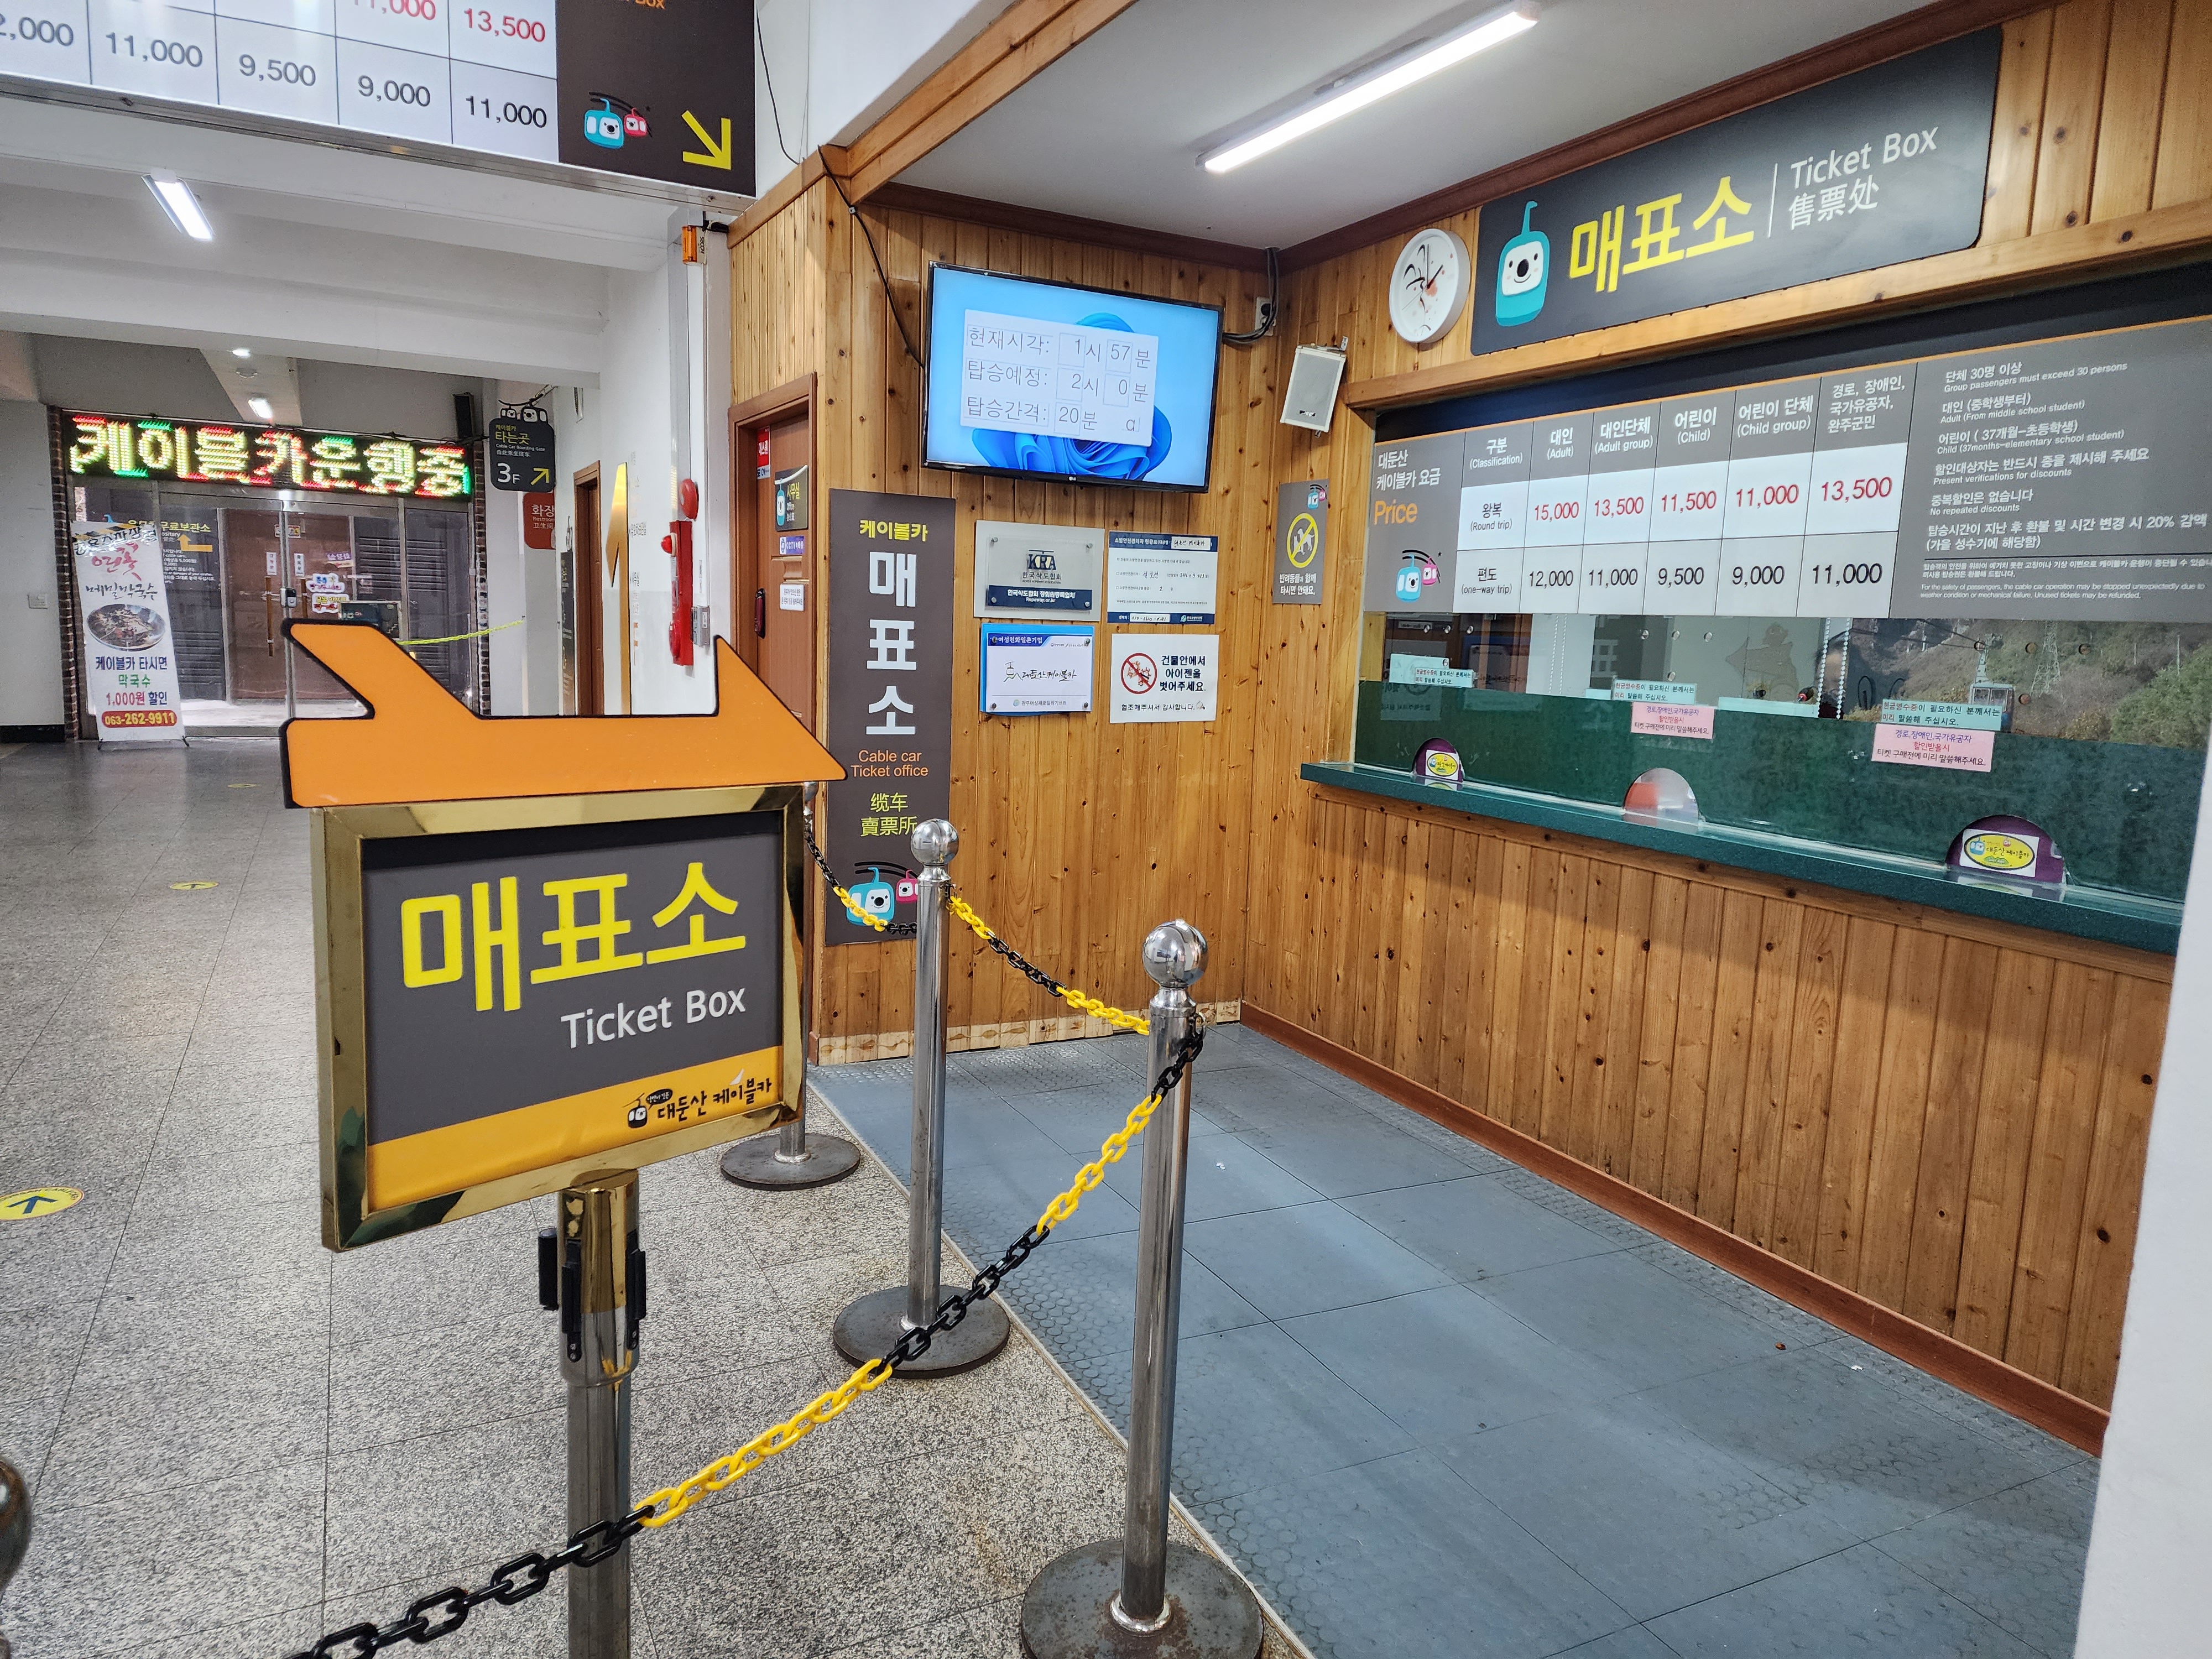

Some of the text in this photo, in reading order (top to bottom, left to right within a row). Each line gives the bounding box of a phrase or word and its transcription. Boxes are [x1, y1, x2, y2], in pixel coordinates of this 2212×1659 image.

[464, 8, 545, 42] 13,500
[106, 32, 202, 67] 11,000
[239, 54, 316, 86] 9,500
[358, 75, 431, 106] 9,000
[466, 96, 547, 127] 11,000
[1791, 126, 1939, 190] Ticket Box
[1789, 174, 1880, 231] 售票处
[1568, 175, 1755, 294] 매표소
[967, 361, 1047, 387] 탑승예정:
[1944, 363, 2128, 393] Group passengers must exceed 30 persons
[1945, 362, 2022, 383] 단체 30명 이상
[1832, 375, 1905, 399] 경로, 장애인,
[967, 396, 1046, 422] 탑승간격:
[1739, 395, 1813, 421] 어린이 단체
[1830, 395, 1893, 416] 국가유공자,
[1940, 399, 2085, 424] Adult (From middle school student)
[1943, 392, 2031, 414] 대인 (중학생부터)
[1601, 416, 1651, 438] 대인단체
[1675, 406, 1717, 430] 어린이
[1737, 416, 1812, 438] (Child group)
[1828, 415, 1876, 434] 완주군민
[495, 431, 530, 445] 타는곳
[1551, 427, 1573, 445] 대인
[1595, 436, 1653, 455] (Adult group)
[1678, 428, 1710, 445] (Child)
[1937, 429, 2125, 455] Child school student)
[1939, 431, 1970, 445] 어린이
[1486, 437, 1507, 455] 구분
[1547, 446, 1574, 460] (Adult)
[1378, 450, 1408, 469] 대둔산
[1470, 452, 1523, 469] (Classification)
[1936, 448, 2150, 476] 할인대상자는 반드시 증을 제시해 주세요
[497, 463, 520, 484] 3F
[1376, 468, 1441, 491] 케이블카 요금
[1933, 467, 2073, 486] Present verifications for discounts
[787, 482, 800, 500] 사무실
[1535, 476, 1892, 523] 15,000 13,500 11,500 11,000 13,500
[1932, 488, 2033, 507] 중복할인은 없습니다
[1374, 500, 1418, 525] Price
[1482, 502, 1502, 519] 왕복
[1943, 505, 1978, 515] repeated
[1981, 504, 2020, 513] discounts
[859, 520, 928, 541] 케이블카
[1470, 519, 1512, 531] (Round trip)
[1928, 514, 2208, 537] 탑승시간이 지난 후 환불 및 시간 변경 시 20% 감액
[1927, 537, 1998, 551] (가을 성수기에
[1280, 573, 1316, 583] 반려동물과 함께
[1478, 567, 1497, 582] 편도
[1529, 563, 1882, 588] 12,000 11,000 9,500 9,000 11,000
[1280, 586, 1296, 596] 타시면
[1462, 583, 1512, 595] (one-way trip)
[866, 551, 917, 734] 매표소
[96, 656, 167, 670] 케이블카 타시면
[1161, 655, 1206, 666] 건물안에서
[118, 674, 150, 688] 막국수
[1166, 669, 1201, 679] 아이젠을
[1160, 681, 1206, 691] 벗어주세요.
[106, 691, 168, 706] 1,000원 할인
[105, 711, 175, 726] 063-262-9911
[1884, 702, 2000, 717] 현금영수증이 필요하신 분께서는
[1898, 714, 1920, 723] 말씀해
[1924, 716, 1959, 726] 주십시오.
[1913, 741, 1950, 752] 할인받을시
[858, 750, 922, 763] Cable car
[1877, 749, 1986, 766] 티켓 구매전에 미리 말씀해주세요.
[851, 764, 928, 777] Ticket office
[870, 792, 908, 812] 缆车
[860, 816, 917, 836] 賣票所
[400, 862, 747, 1013] 매표소
[561, 988, 745, 1049] Ticket Box
[658, 1078, 772, 1123] 대둔산 케이블카
